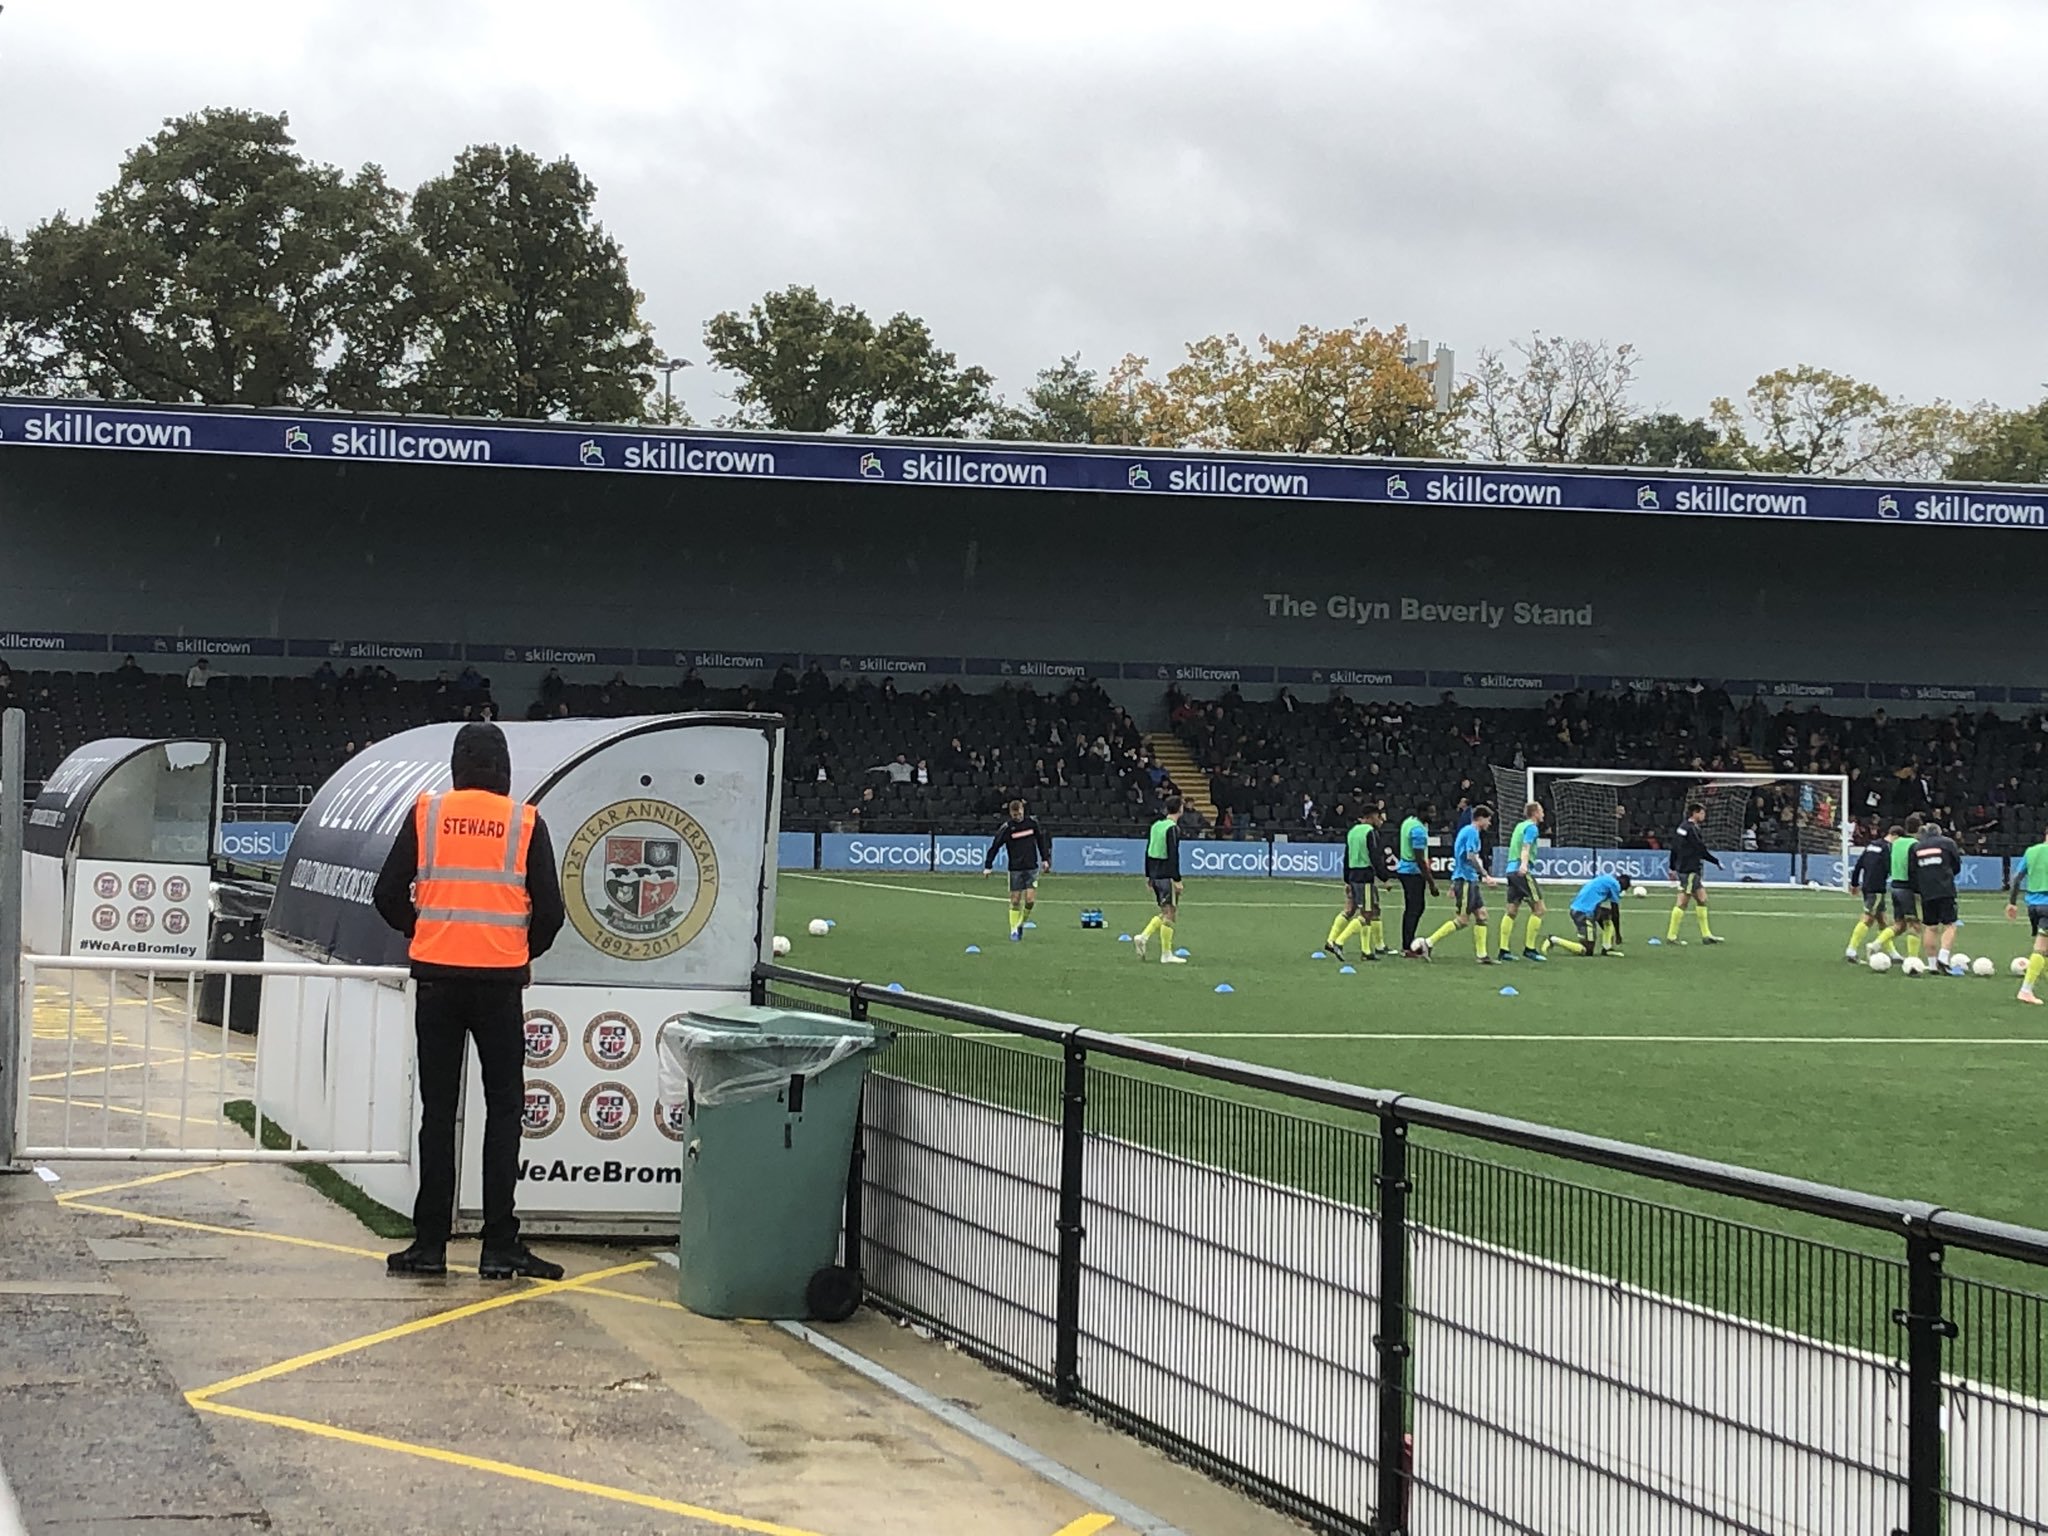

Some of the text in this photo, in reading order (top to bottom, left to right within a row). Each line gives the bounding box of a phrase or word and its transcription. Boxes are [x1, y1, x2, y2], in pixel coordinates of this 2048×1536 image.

[25, 413, 191, 447] skillcrown
[332, 428, 491, 460] skillcrown
[624, 442, 775, 473] skillcrown
[902, 454, 1047, 485] skillcrown
[1169, 465, 1308, 495] skillcrown
[1427, 475, 1561, 505] skillcrown
[1675, 486, 1806, 515] skillcrown
[1915, 496, 2045, 525] skillcrown
[1263, 594, 1593, 628] The Glyn Beverly Stand
[0, 633, 65, 649] killcrown
[176, 639, 251, 655] skillcrown
[350, 643, 423, 659] skillcrown
[525, 648, 596, 664] skillcrown
[695, 653, 763, 668] skillcrown
[859, 657, 926, 672] skillcrown
[1019, 661, 1085, 676] skillcrown
[1176, 666, 1240, 681] skillcrown
[1330, 670, 1392, 685] skillcrown
[1480, 674, 1543, 689] skillcrown
[443, 816, 505, 839] STEWARD
[219, 831, 292, 854] osisU
[566, 803, 716, 886] 125 YEAR ANNIVERSARY
[1191, 847, 1344, 872] SarcoidosisUK
[1533, 855, 1670, 878] arcoidosisUK
[80, 939, 197, 957] #WeAreBromley
[593, 930, 682, 957] 1892-2017
[517, 1159, 682, 1183] eAreBrom
